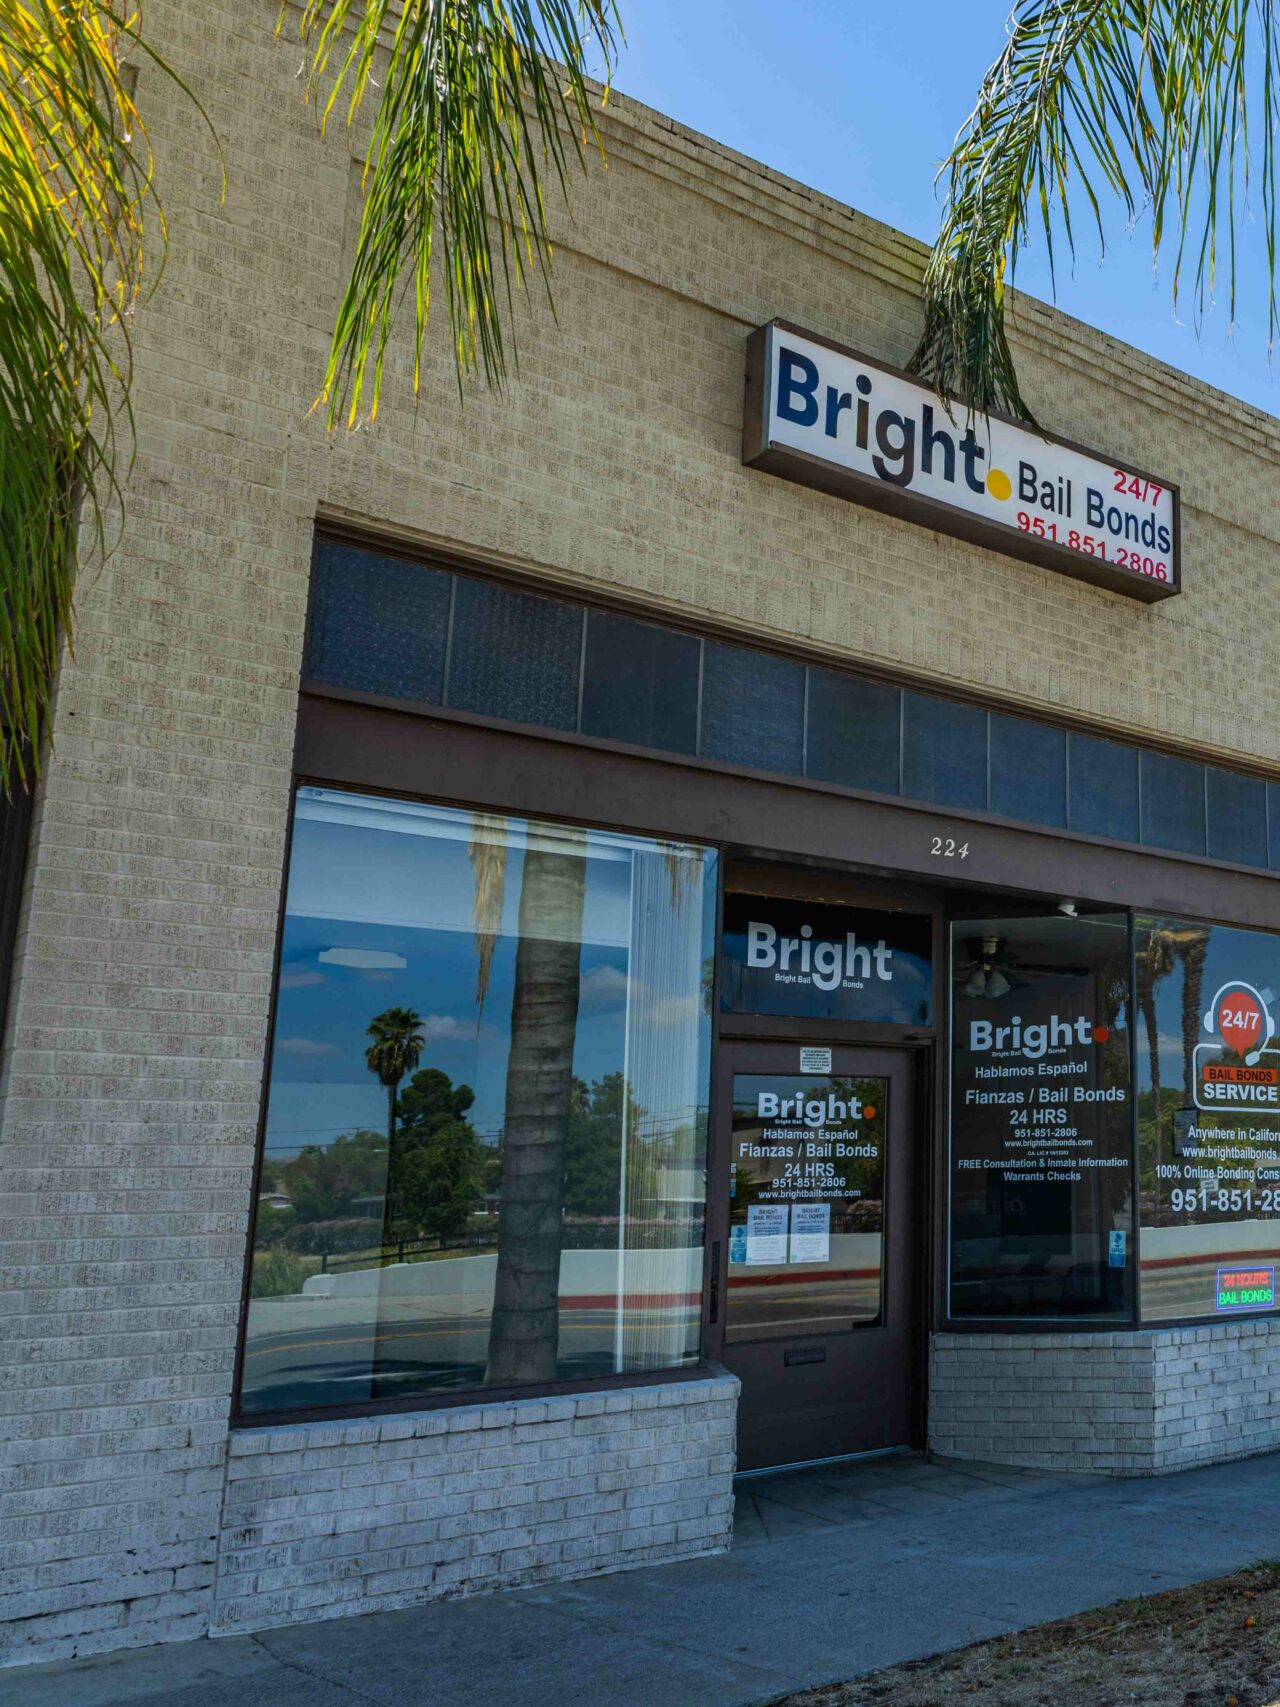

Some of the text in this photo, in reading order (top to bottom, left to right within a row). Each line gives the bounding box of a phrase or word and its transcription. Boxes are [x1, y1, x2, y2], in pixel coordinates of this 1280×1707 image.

[1114, 470, 1162, 506] 24/7
[1019, 460, 1171, 554] Bail Bonds
[1017, 512, 1167, 581] 951.851.2806
[931, 836, 969, 859] 224
[747, 921, 892, 991] Bright
[775, 973, 864, 989] Bright Bail Bonds
[1222, 1009, 1259, 1030] 24/7
[992, 1050, 1009, 1058] Bright
[975, 1061, 1087, 1079] Hablamos Español
[1209, 1068, 1273, 1082] BAIL BONDS
[966, 1086, 1125, 1104] Fianzas / Bail Bonds
[1203, 1083, 1278, 1101] SERVICE
[1010, 1109, 1067, 1124] 24 HRS
[763, 1129, 858, 1141] Hablamos Español
[1014, 1128, 1077, 1138] 951-851-2806
[1188, 1125, 1235, 1141] Anywhere
[1238, 1128, 1246, 1140] in
[740, 1143, 878, 1157] Fianzas / Bail Bonds
[1005, 1139, 1093, 1148] www.brightbailbonds.com
[785, 1163, 834, 1177] 24 HRS
[958, 1157, 1128, 1169] FREE Consultation & Inmate Information
[1003, 1171, 1081, 1181] Warrants Checks
[1155, 1165, 1181, 1178] 100%
[1184, 1165, 1214, 1178] Online
[1216, 1167, 1254, 1182] Bonding
[772, 1178, 846, 1188] 951-851-2806
[758, 1189, 861, 1199] www.brightbailbonds.com
[1223, 1271, 1269, 1287] 24 HOURS
[1219, 1289, 1273, 1305] BAIL BONDS
